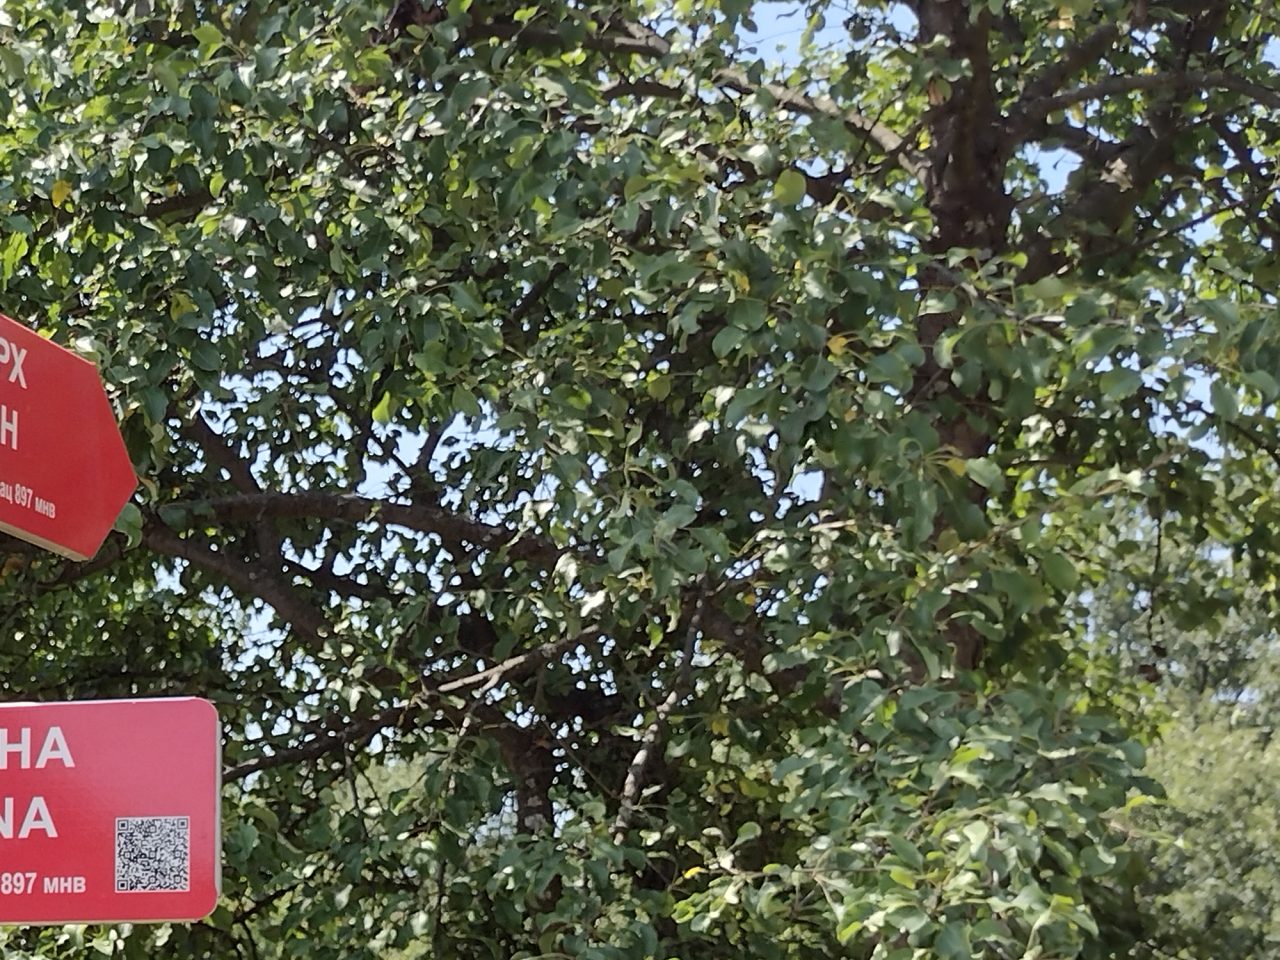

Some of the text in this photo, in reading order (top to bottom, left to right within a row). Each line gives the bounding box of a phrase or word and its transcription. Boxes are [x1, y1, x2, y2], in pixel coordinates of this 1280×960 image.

[15, 483, 33, 510] 897
[35, 497, 56, 520] мнв
[1, 872, 38, 895] 897
[43, 877, 87, 895] мнв
